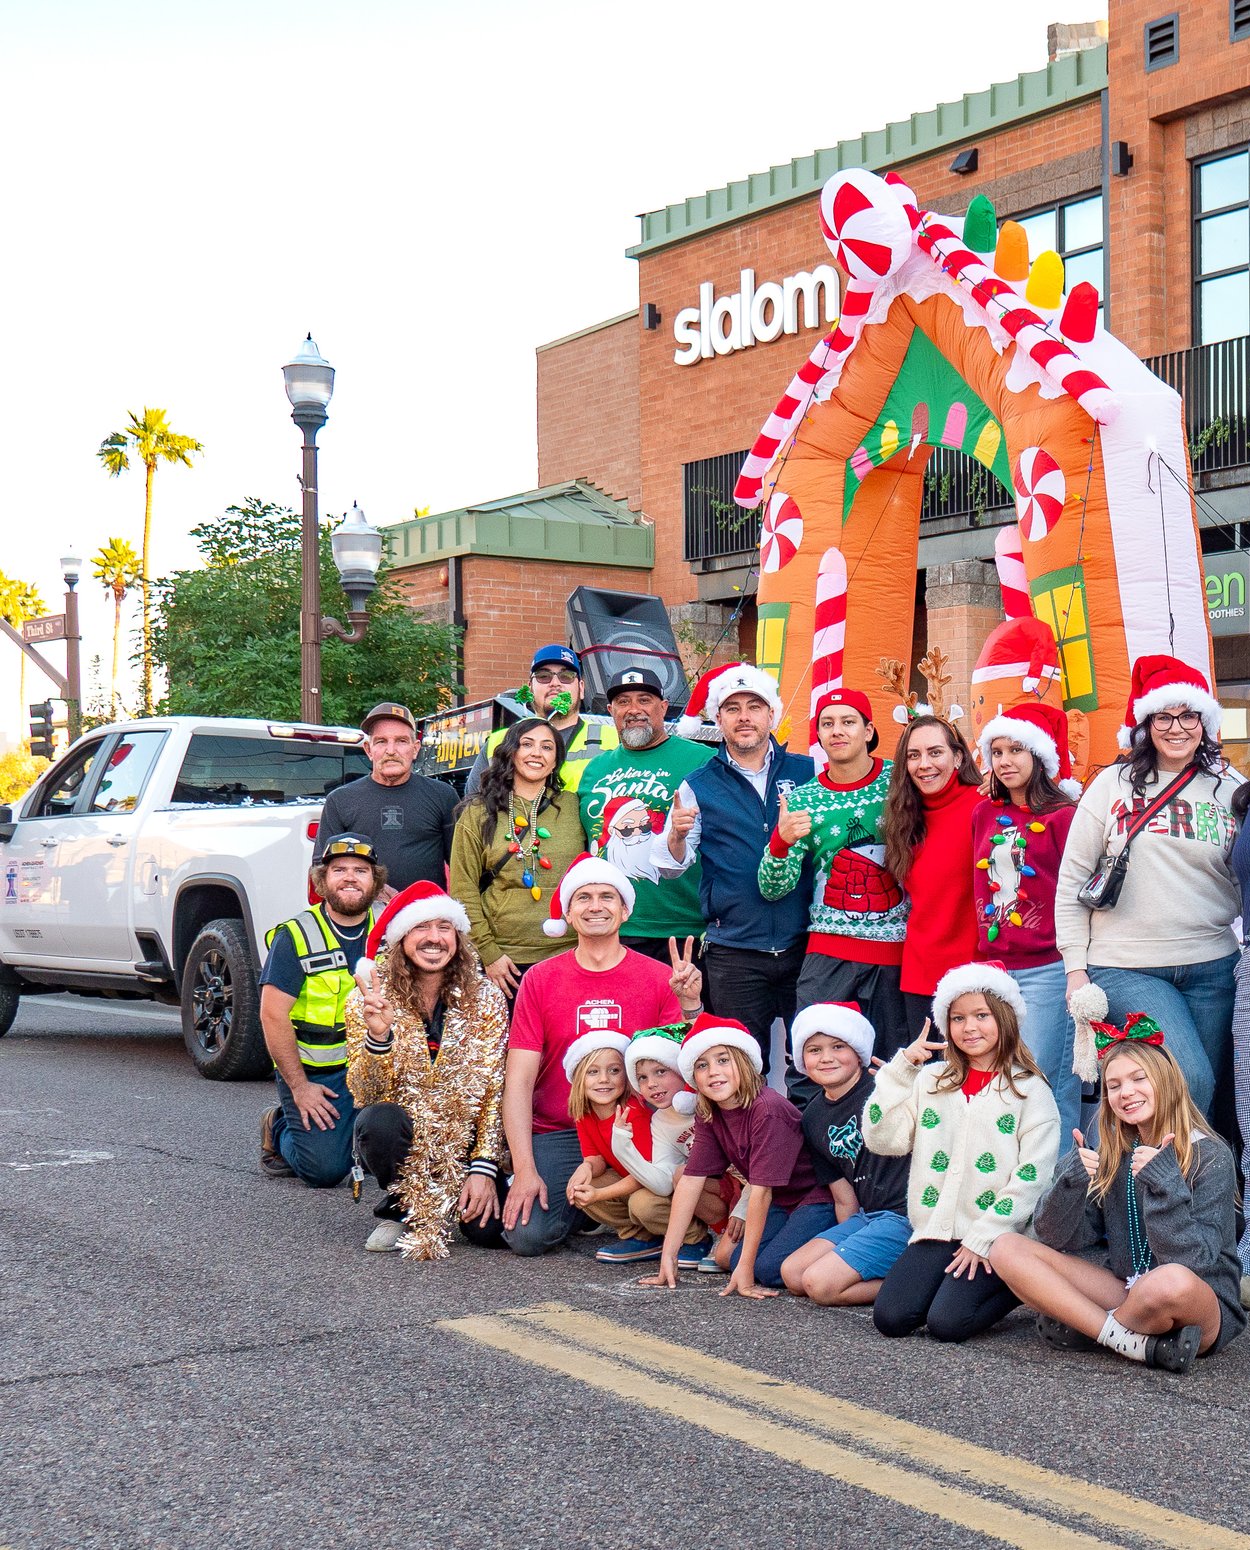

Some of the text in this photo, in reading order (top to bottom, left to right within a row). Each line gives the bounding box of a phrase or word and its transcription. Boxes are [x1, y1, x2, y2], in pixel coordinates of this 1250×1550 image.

[673, 264, 841, 366] slalom
[1205, 572, 1245, 609] en
[1209, 607, 1245, 619] OOTHIES
[26, 622, 54, 637] Third St
[606, 767, 671, 785] Believe in
[587, 774, 676, 818] Santa
